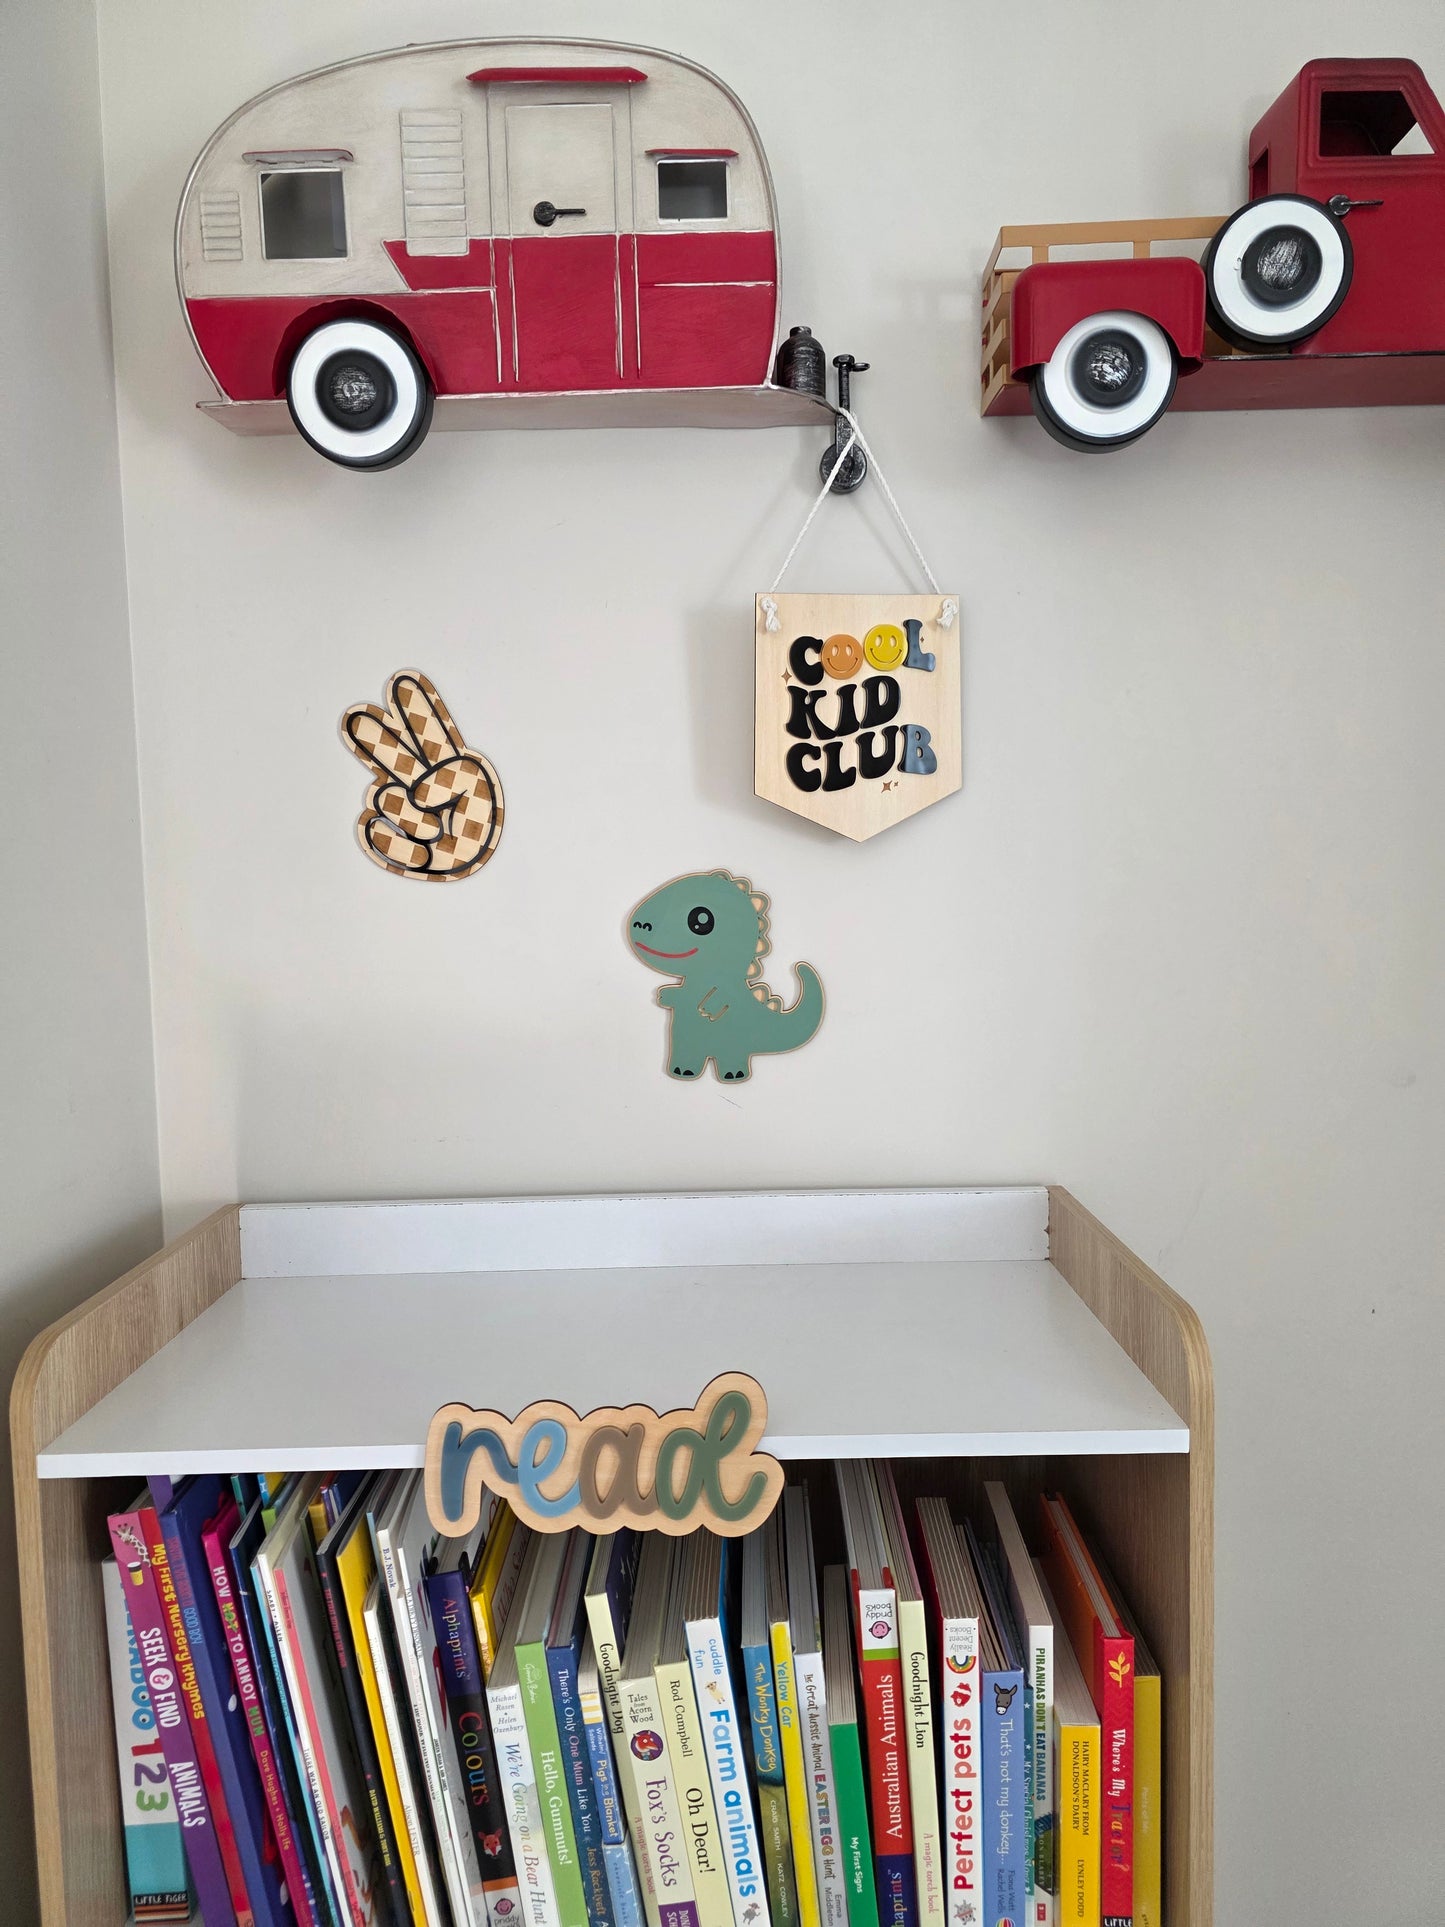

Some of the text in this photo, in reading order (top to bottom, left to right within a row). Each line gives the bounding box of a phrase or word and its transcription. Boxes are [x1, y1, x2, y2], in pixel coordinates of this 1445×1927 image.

[789, 618, 937, 686] COOL
[785, 675, 902, 741] KID
[785, 723, 938, 793] CLUB
[440, 1390, 769, 1523] read
[212, 1565, 232, 1598] HOW
[385, 1563, 397, 1589] Novak
[865, 1602, 893, 1610] books
[865, 1608, 893, 1619] priddy
[151, 1543, 206, 1720] My First Nursery Rhymes
[230, 1634, 245, 1653] TO
[274, 1621, 284, 1643] ALLEN
[442, 1598, 467, 1680] Alphaprints
[948, 1635, 974, 1643] Decent
[950, 1643, 973, 1653] Really
[693, 1650, 706, 1669] fun
[708, 1638, 725, 1676] cuddle
[235, 1657, 257, 1701] ANNOY
[599, 1642, 625, 1734] Goodnight Dog
[627, 1693, 649, 1703] Tales
[776, 1661, 793, 1729] Yellow Car
[805, 1682, 817, 1711] Great
[495, 1703, 516, 1712] Rosen
[629, 1706, 653, 1715] Acorn
[630, 1713, 655, 1724] Wood
[669, 1680, 694, 1758] Rod Campbell
[752, 1662, 777, 1774] The Wonky Donkey
[909, 1651, 931, 1749] Goodnight Lion
[139, 1627, 168, 1667] SEEK
[154, 1691, 181, 1729] FIND
[168, 1760, 206, 1828] ANIMALS
[493, 1724, 525, 1736] Oxenbury
[498, 1716, 518, 1726] Helen
[807, 1710, 821, 1742] Aussie
[1000, 1718, 1014, 1758] That's
[1035, 1647, 1047, 1802] PIRANHAS DON'T EAT BANANAS
[459, 1711, 490, 1806] Colours
[557, 1668, 594, 1833] There's Only One Mum Like You
[810, 1743, 826, 1773] Animal
[875, 1674, 903, 1840] Australian Animals
[134, 1762, 168, 1787] 2
[309, 1771, 319, 1790] WAS
[999, 1760, 1013, 1782] not
[1072, 1740, 1080, 1831] DONALDSON'S DAIRY
[1082, 1740, 1090, 1836] HAIRY MACLARY FROM
[135, 1789, 170, 1812] 3
[260, 1750, 270, 1773] Dave
[265, 1773, 280, 1807] Hughes
[275, 1812, 289, 1837] Holly
[312, 1789, 321, 1800] AN
[315, 1800, 325, 1816] OLD
[540, 1750, 574, 1867] Hello, Gumnuts!
[595, 1760, 620, 1839] Pigs Blanket
[708, 1708, 760, 1898] Farm animals
[814, 1773, 831, 1826] EASTER
[949, 1717, 977, 1890] Perfect pets
[996, 1784, 1009, 1807] my
[1107, 1729, 1131, 1873] Where's My Tractor?
[319, 1816, 330, 1841] SAILOR
[504, 1742, 548, 1927] We're Going on a Bear Hunt
[645, 1776, 681, 1888] Fox's Socks
[685, 1787, 717, 1874] Oh Dear!
[771, 1826, 783, 1853] SMITH
[819, 1827, 835, 1857] EGG
[586, 1847, 599, 1869] Jess
[634, 1816, 657, 1894] A magic torch book
[776, 1863, 786, 1885] KATZ
[822, 1858, 837, 1880] Hunt
[849, 1836, 864, 1894] My First Signs
[922, 1831, 939, 1914] A magic torch book
[778, 1886, 790, 1919] COWLEY
[824, 1887, 834, 1927] Middleton
[834, 1894, 843, 1919] Emma
[1077, 1859, 1085, 1918] LYNLEY DODD
